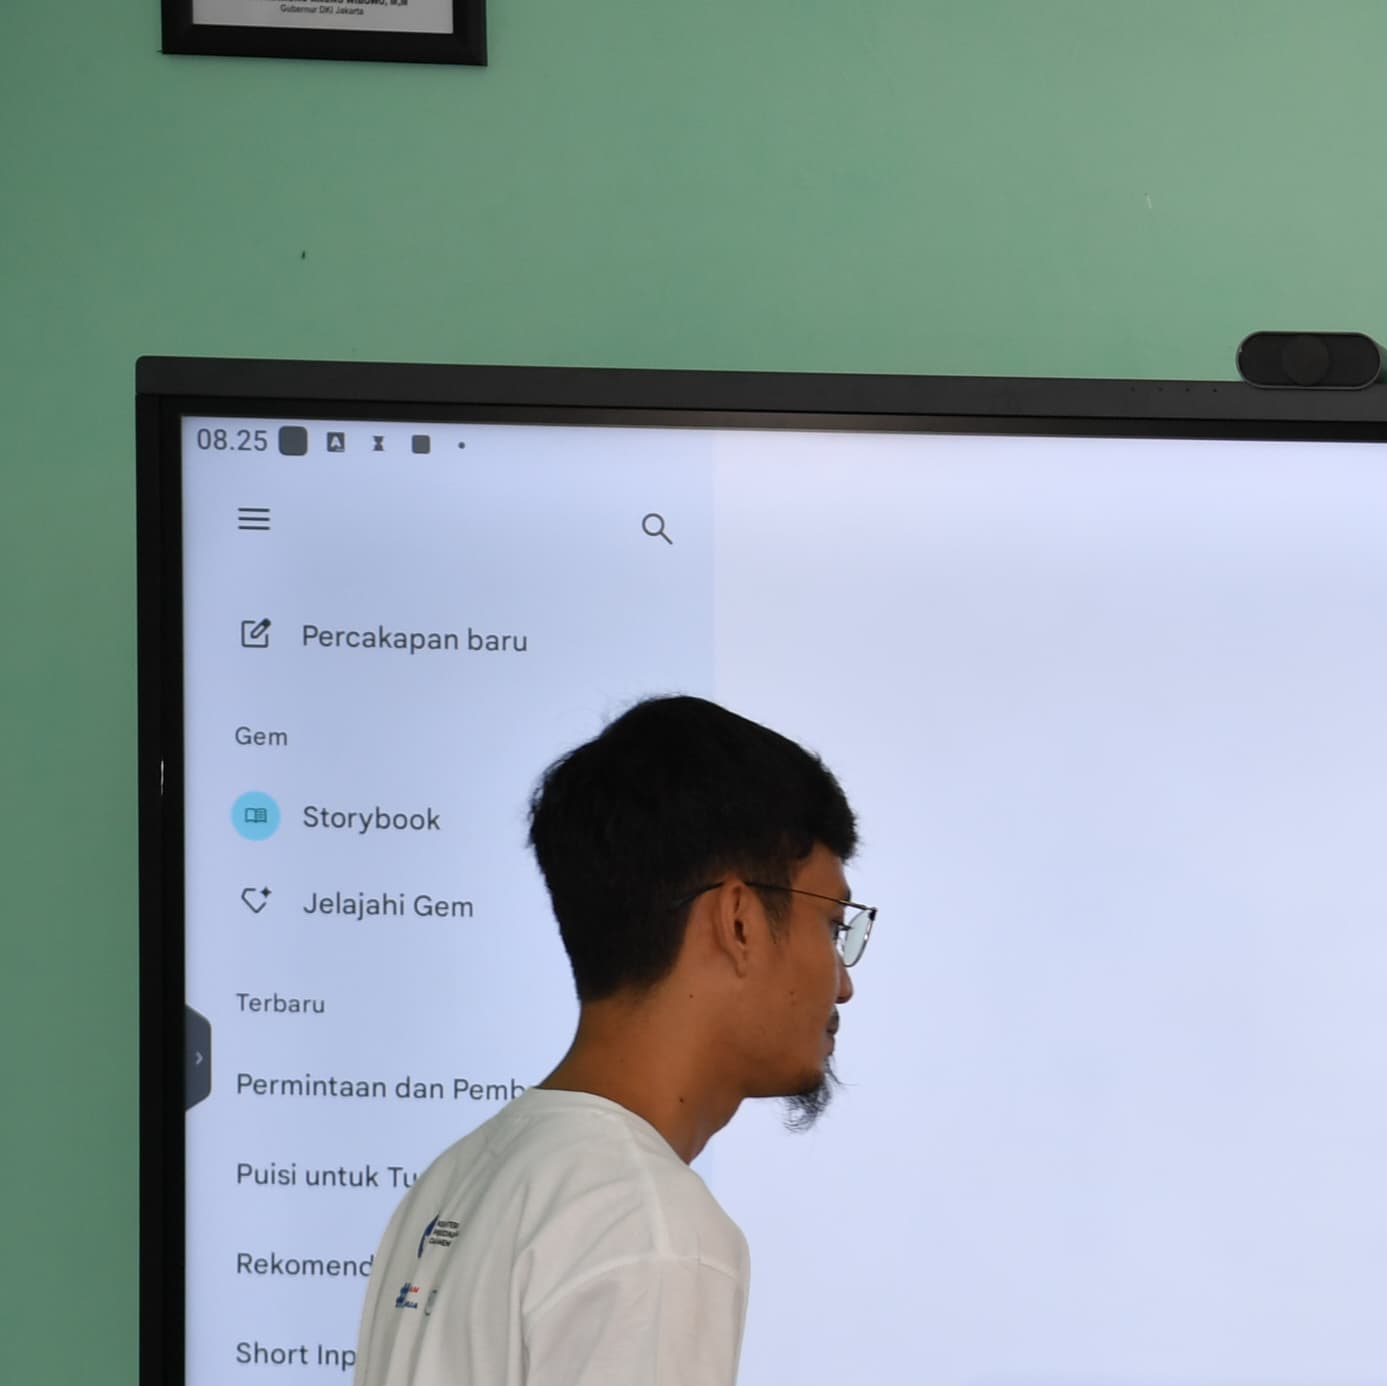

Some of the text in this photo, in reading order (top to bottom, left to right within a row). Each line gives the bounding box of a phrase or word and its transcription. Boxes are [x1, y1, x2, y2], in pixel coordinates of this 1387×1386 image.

[280, 4, 365, 16] Gubernur DKI Jakarta
[196, 427, 268, 452] 08.25
[302, 624, 528, 655] Percakapan baru
[234, 726, 288, 747] Gem
[303, 805, 441, 834] Storybook
[303, 891, 473, 921] Jelajahi Gem
[236, 992, 325, 1014] Terbaru
[237, 1073, 387, 1098] Permintaan
[394, 1075, 444, 1099] dan
[237, 1162, 297, 1186] Puisi
[305, 1164, 379, 1188] untuk
[236, 1341, 356, 1372] Short Inp
